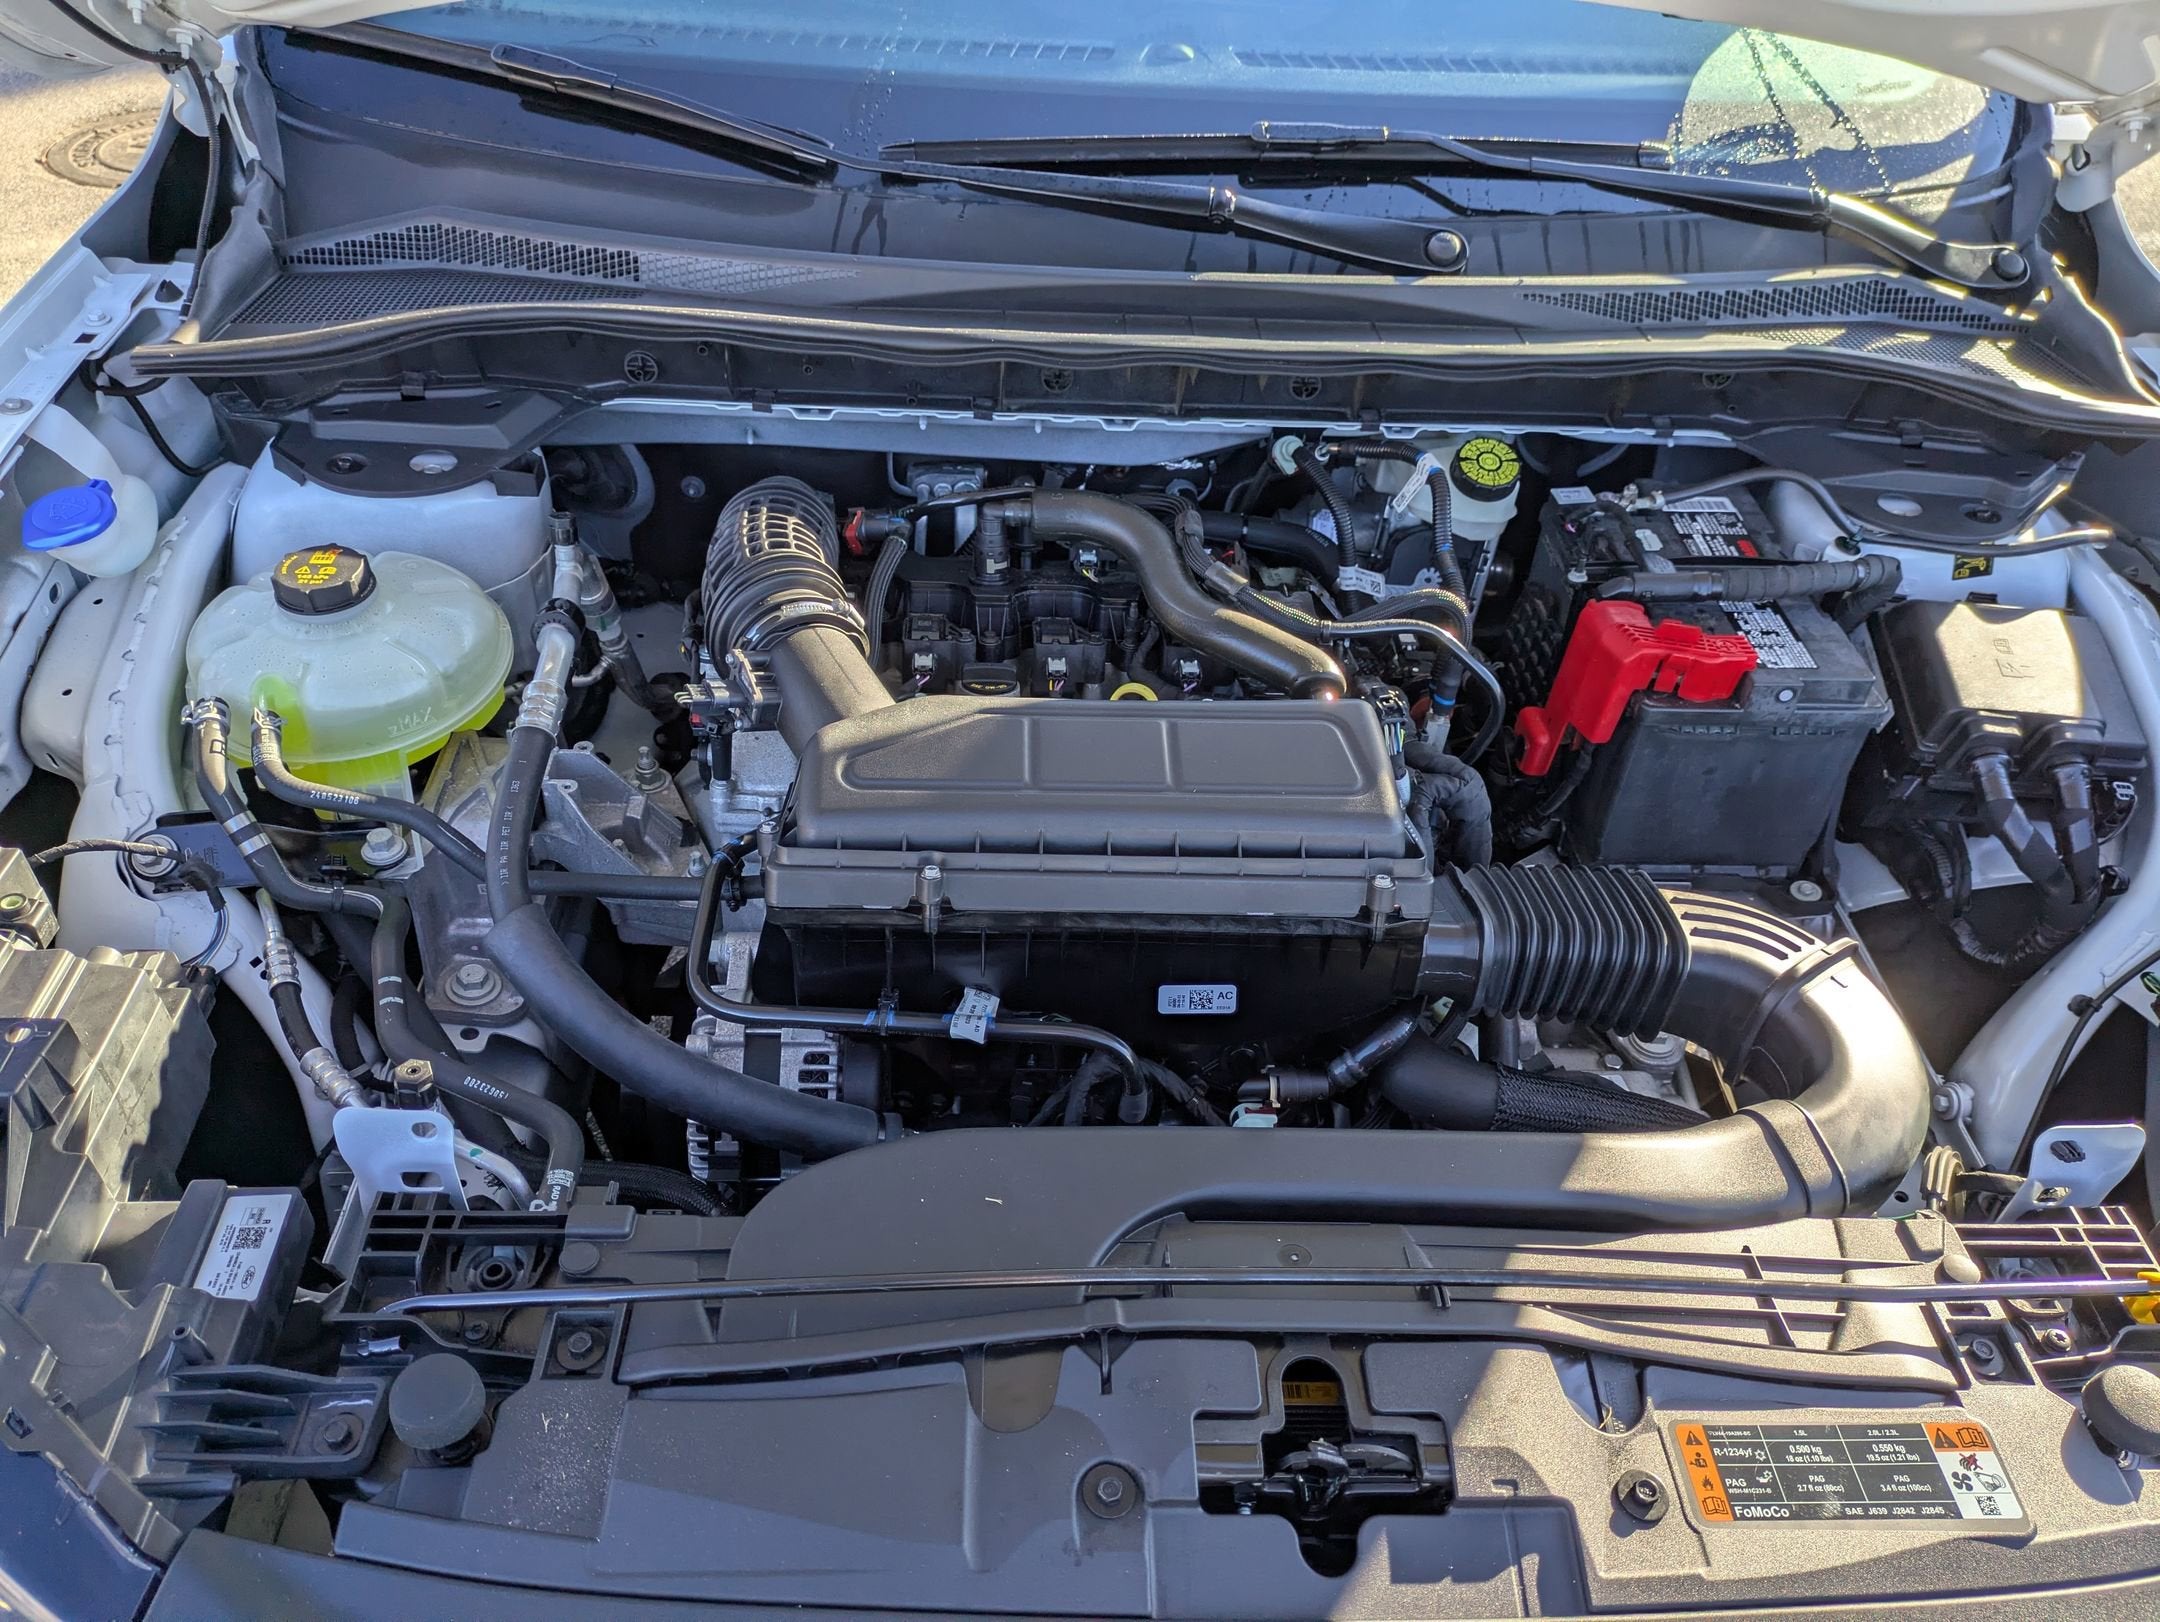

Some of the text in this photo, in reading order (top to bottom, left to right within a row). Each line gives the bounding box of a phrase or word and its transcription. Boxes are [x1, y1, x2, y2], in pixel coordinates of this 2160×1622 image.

[1217, 991, 1233, 1000] AC
[551, 1185, 561, 1200] RAD
[1713, 1447, 1752, 1458] R-1234yf
[1789, 1445, 1823, 1455] 0.500 kg
[1872, 1443, 1906, 1454] 0.550 kg
[1866, 1454, 1881, 1462] 19.5
[1725, 1478, 1747, 1488] PAG
[1808, 1475, 1825, 1483] PAG
[1893, 1474, 1910, 1482] PAG
[1797, 1484, 1807, 1492] 2.7
[1880, 1484, 1892, 1492] 3.4
[1906, 1483, 1932, 1493] (100cc)
[1733, 1505, 1945, 1518] FoMoCo SAE J639 J2842 J2845
